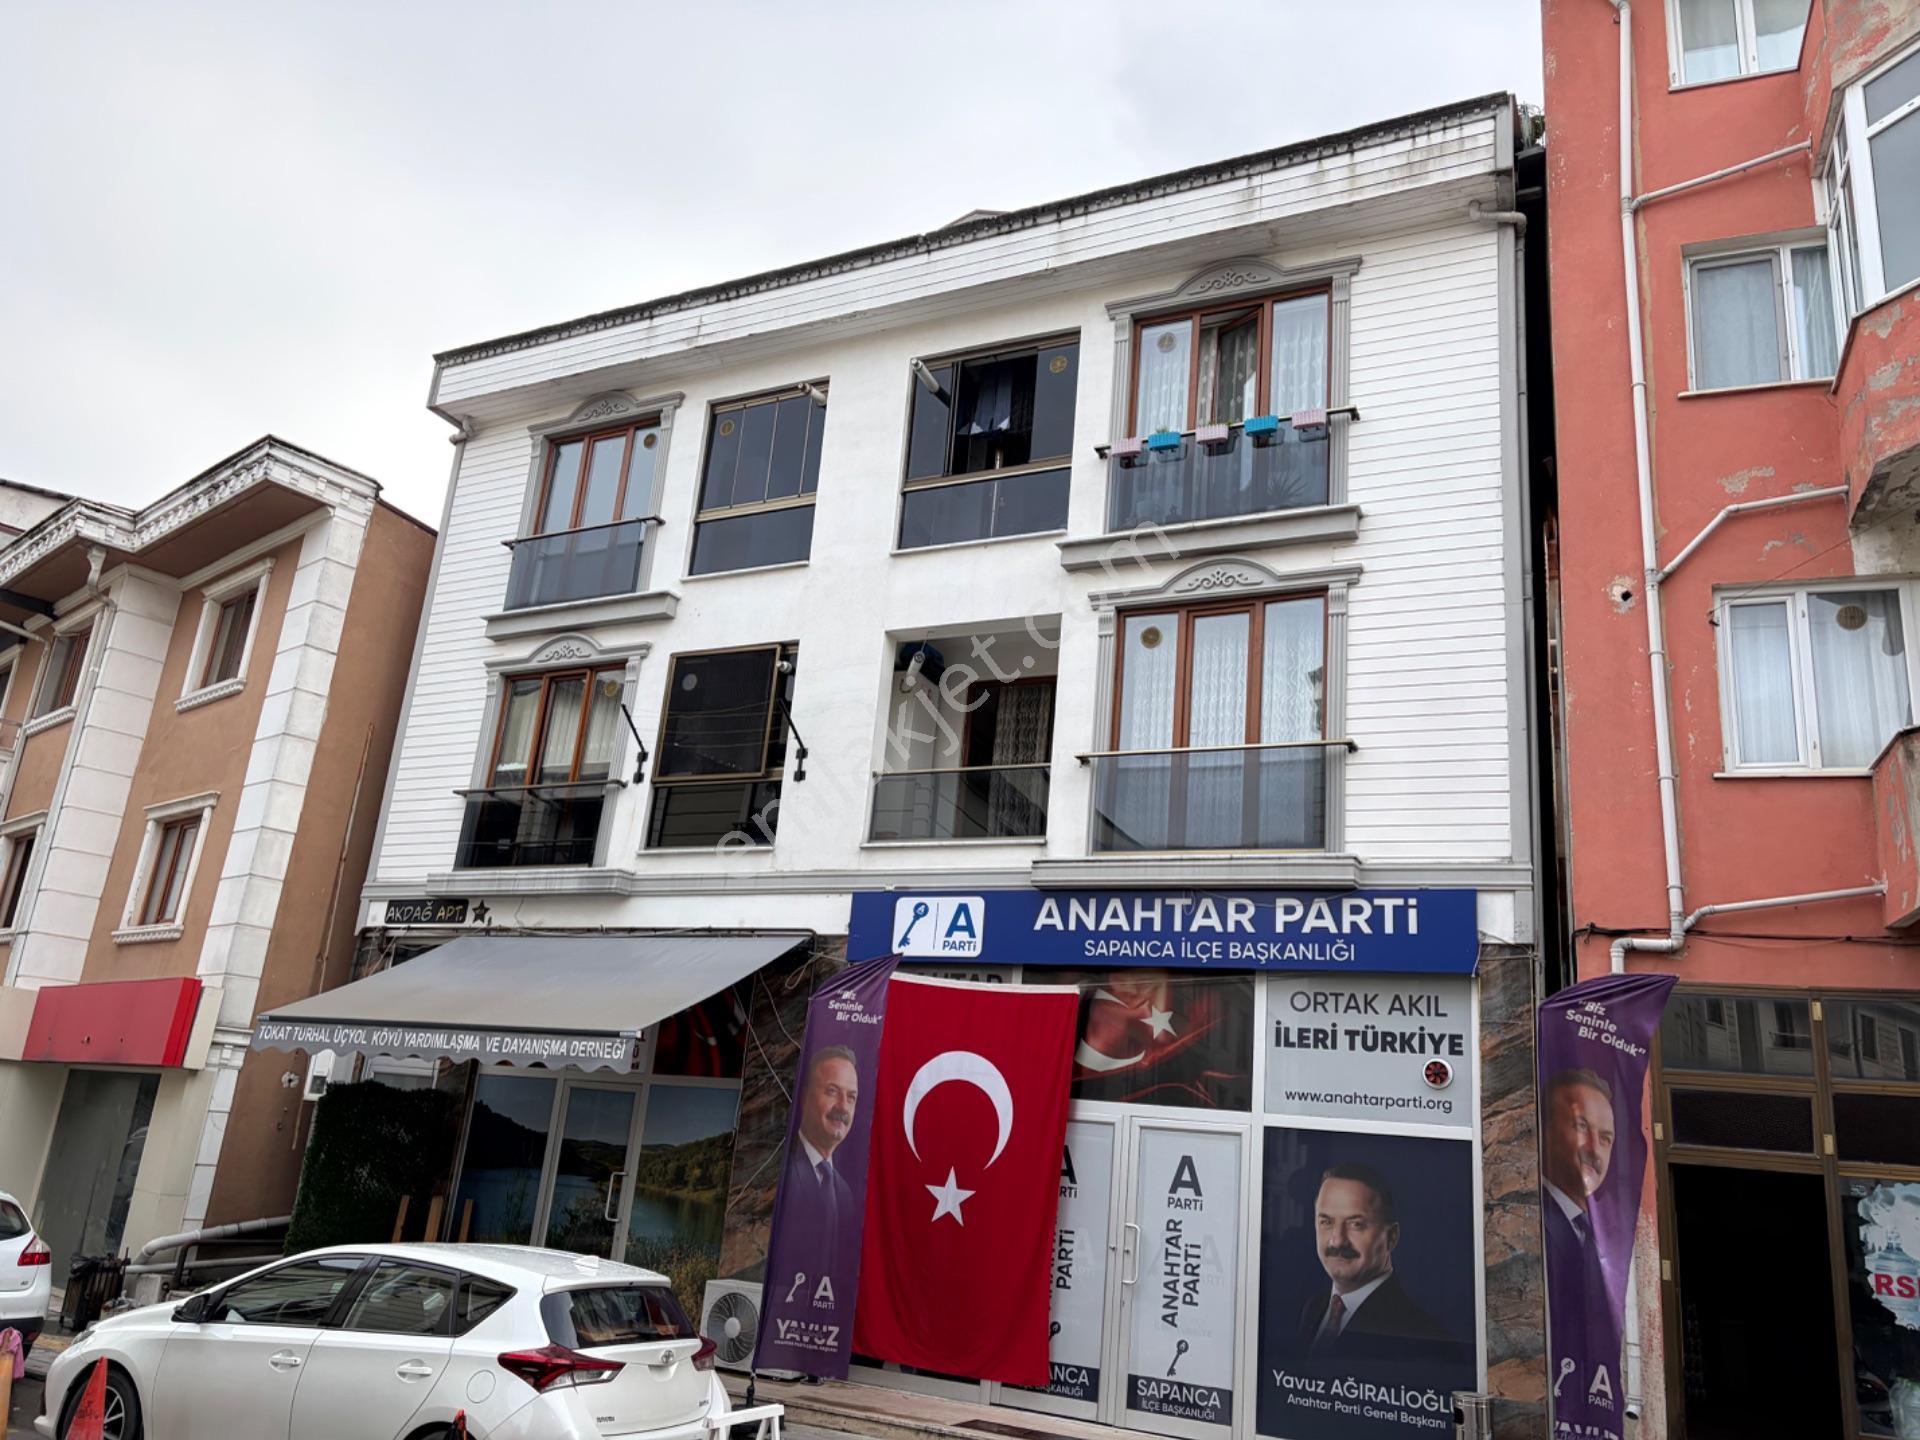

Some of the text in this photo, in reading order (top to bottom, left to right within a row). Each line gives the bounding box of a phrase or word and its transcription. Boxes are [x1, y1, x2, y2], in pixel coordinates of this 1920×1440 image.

[386, 900, 463, 921] AKDAĞ APT.
[944, 902, 977, 939] A
[1033, 897, 1257, 934] ANAHTAR
[1084, 936, 1356, 965] SAPANCA İLÇE BAŞKANLIĞI
[827, 1000, 864, 1013] Seninle
[836, 1011, 850, 1023] Bir
[1290, 990, 1449, 1018] ORTAK AKIL
[1565, 1009, 1618, 1034] Seninle
[1577, 1025, 1599, 1041] Bir
[258, 1025, 290, 1041] TOKAT
[292, 1026, 331, 1044] TURHAL
[332, 1026, 368, 1047] ÜÇYOL
[370, 1029, 403, 1048] KÖYÜ
[403, 1032, 480, 1054] YARDIMLAŞMA
[485, 1036, 501, 1053] VE
[501, 1037, 567, 1060] DAYANIŞMA
[569, 1038, 626, 1060] DERNEĞİ
[1274, 1019, 1465, 1057] İLERİ TÜRKİYE
[1284, 1089, 1453, 1114] www.anahtarparti.org
[1168, 1155, 1203, 1197] A
[1161, 1218, 1183, 1328] ANAHTAR
[1873, 1272, 1920, 1299] RS
[814, 1276, 834, 1301] A
[776, 1318, 840, 1346] YAVUZ
[1137, 1379, 1221, 1409] SAPANCA
[1272, 1369, 1326, 1394] Yavuz
[1588, 1363, 1614, 1401] A
[1141, 1400, 1216, 1421] İLÇE BAŞKANLIĞI
[1287, 1394, 1446, 1429] Anahtar Parti Genel Başkanı
